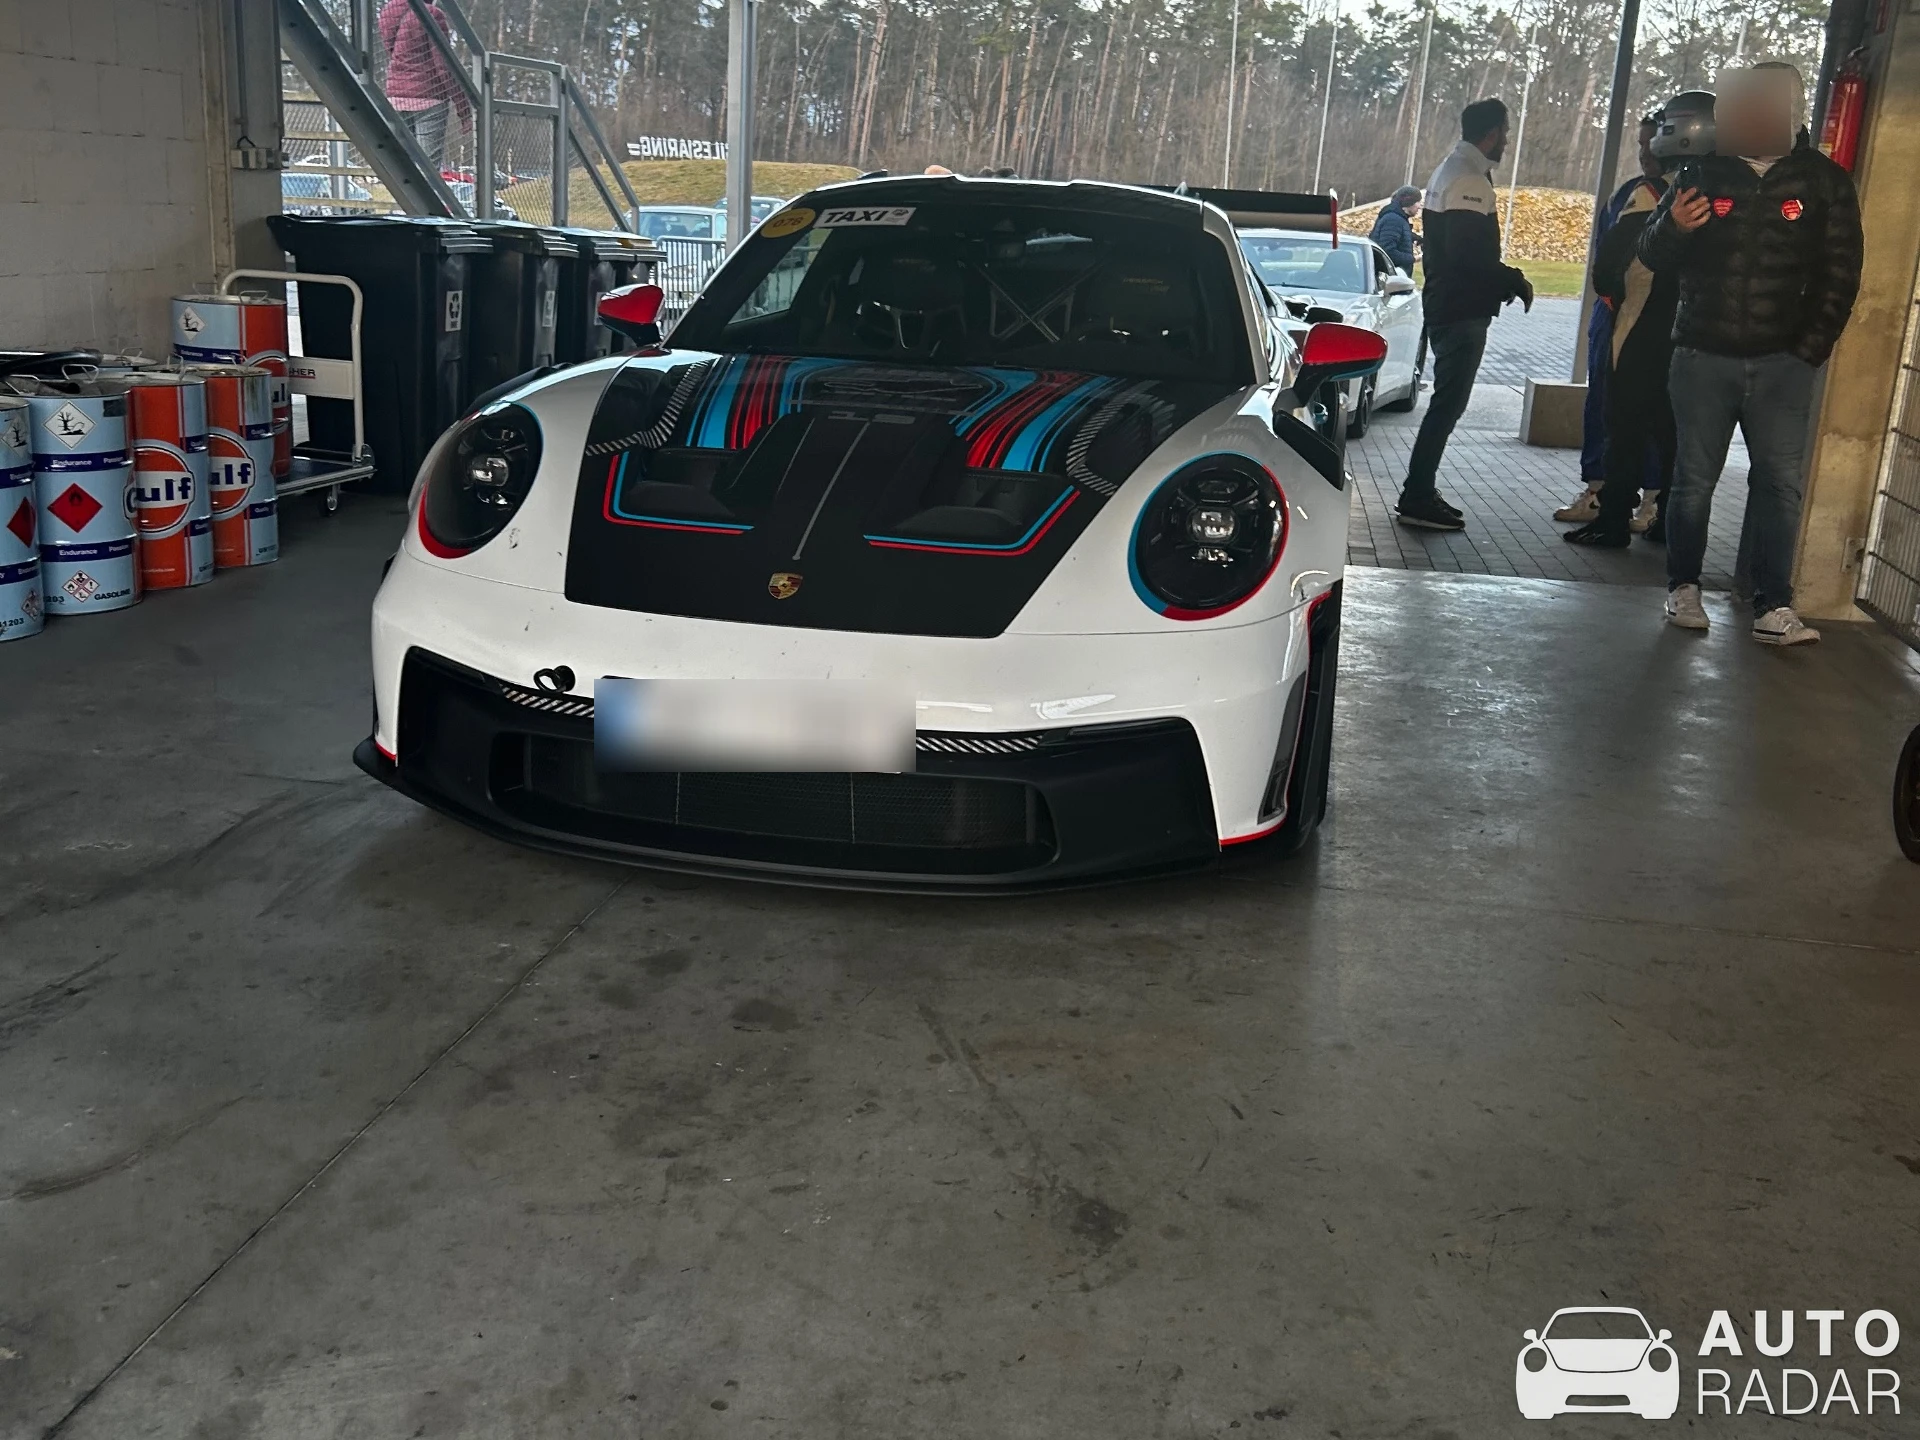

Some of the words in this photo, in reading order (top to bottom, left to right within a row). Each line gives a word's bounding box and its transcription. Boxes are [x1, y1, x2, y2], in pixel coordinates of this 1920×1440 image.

[824, 210, 889, 223] TAXI
[52, 459, 92, 467] Endurance
[59, 548, 98, 556] Endurance
[94, 588, 131, 601] GASOLINE
